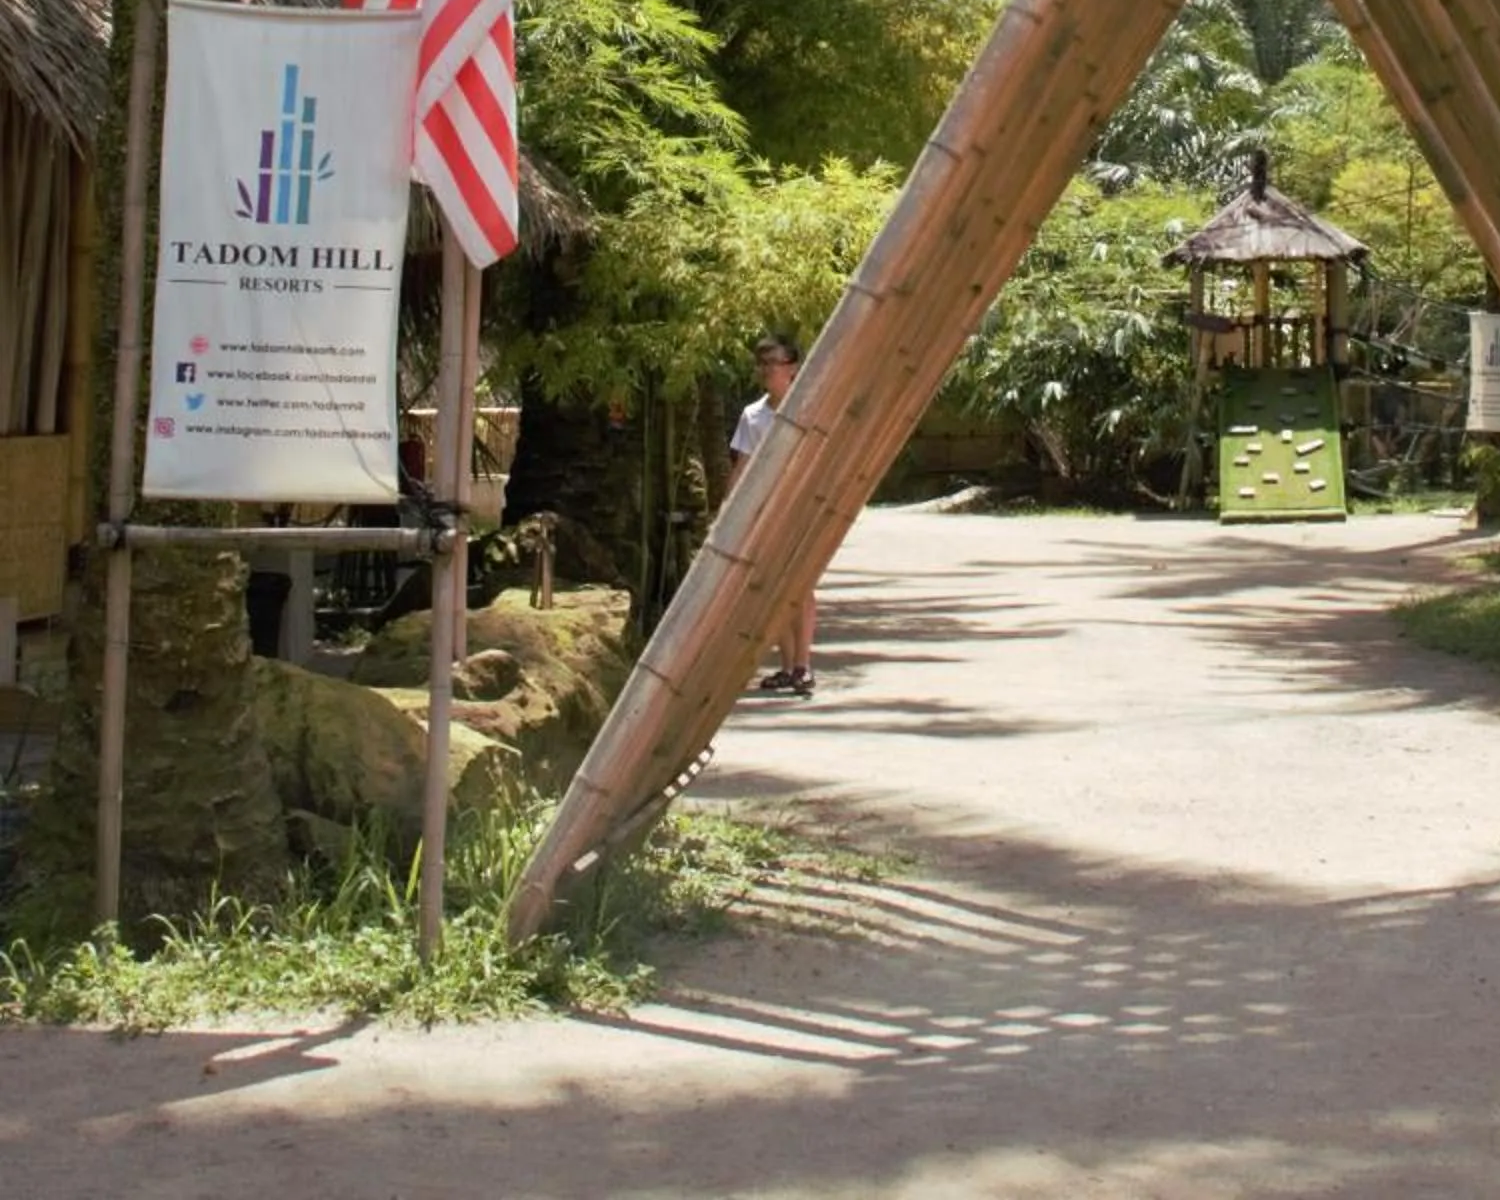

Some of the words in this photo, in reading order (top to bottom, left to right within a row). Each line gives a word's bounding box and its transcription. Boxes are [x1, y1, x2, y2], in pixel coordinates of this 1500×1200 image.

[171, 241, 298, 267] TADOM
[311, 247, 393, 271] HILL
[239, 277, 324, 293] RESORTS
